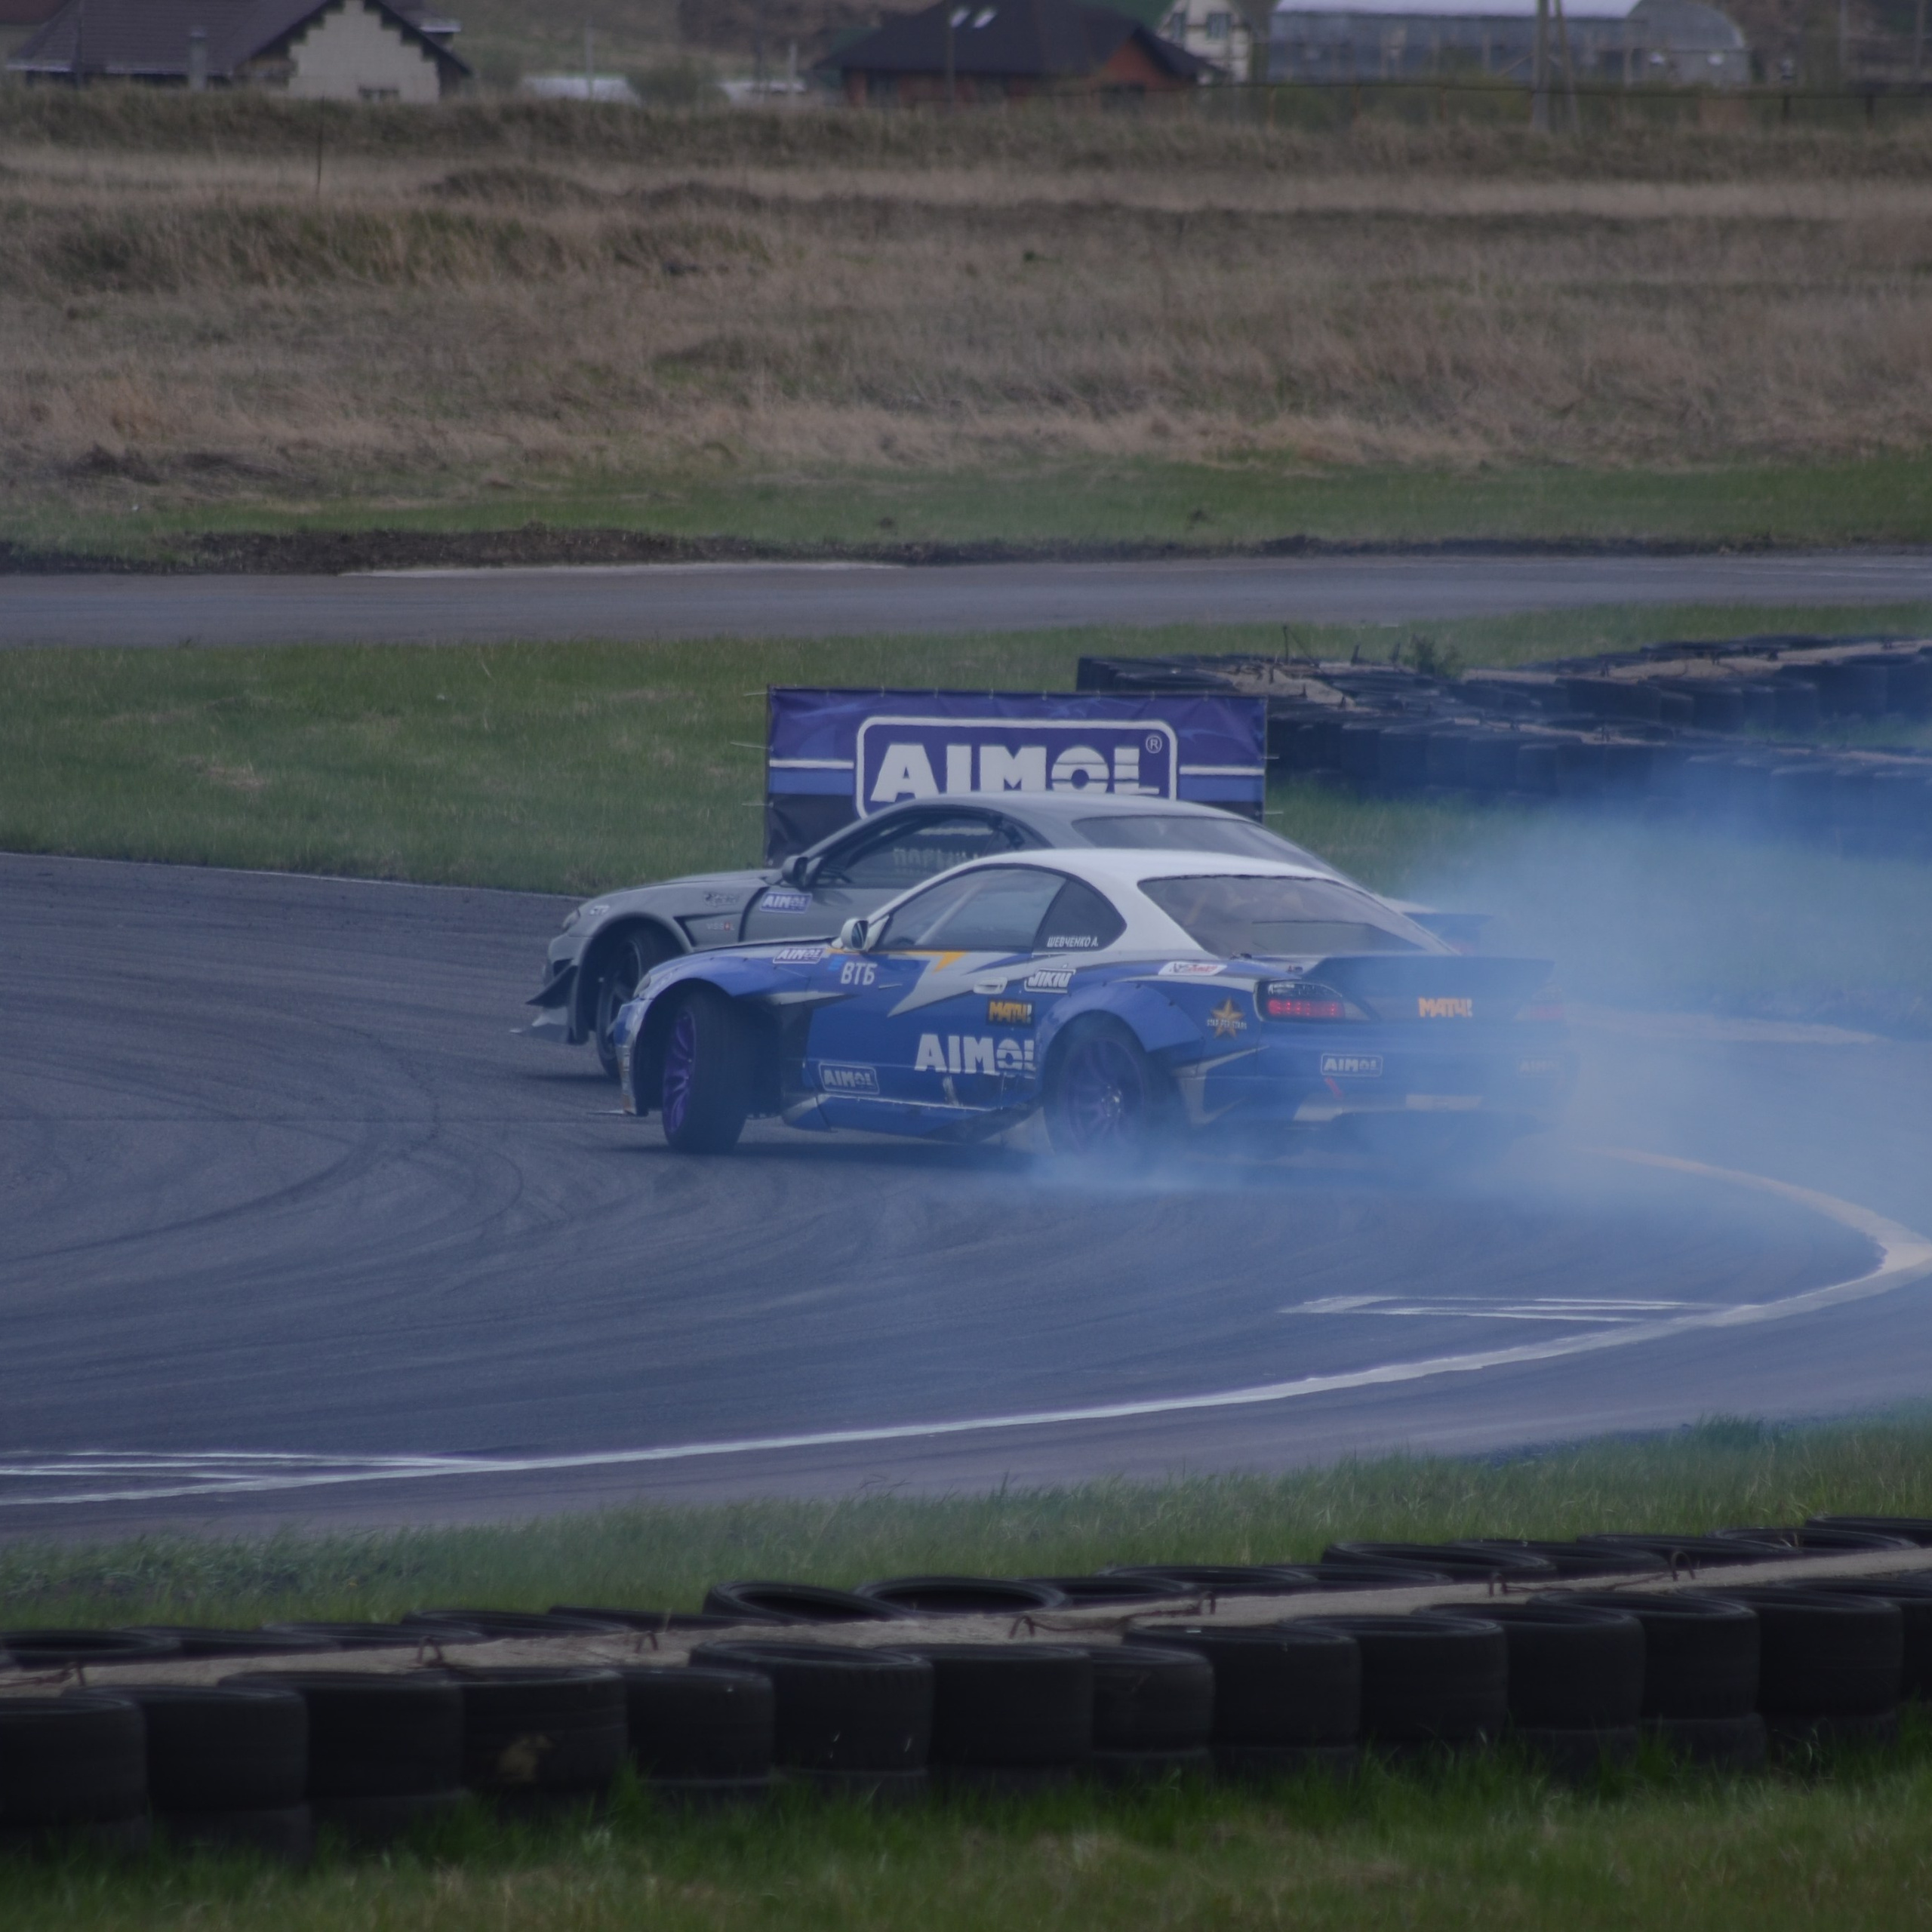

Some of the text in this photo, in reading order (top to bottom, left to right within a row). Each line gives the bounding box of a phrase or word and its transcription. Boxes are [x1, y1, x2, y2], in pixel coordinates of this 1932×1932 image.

[762, 894, 806, 910] AIMOL
[1046, 936, 1091, 948] ШЕВЧЕНКО
[777, 949, 821, 960] AIMOL
[841, 961, 878, 986] ВТБ
[1324, 1058, 1379, 1072] AIMOL
[823, 1069, 875, 1089] AIMOL
